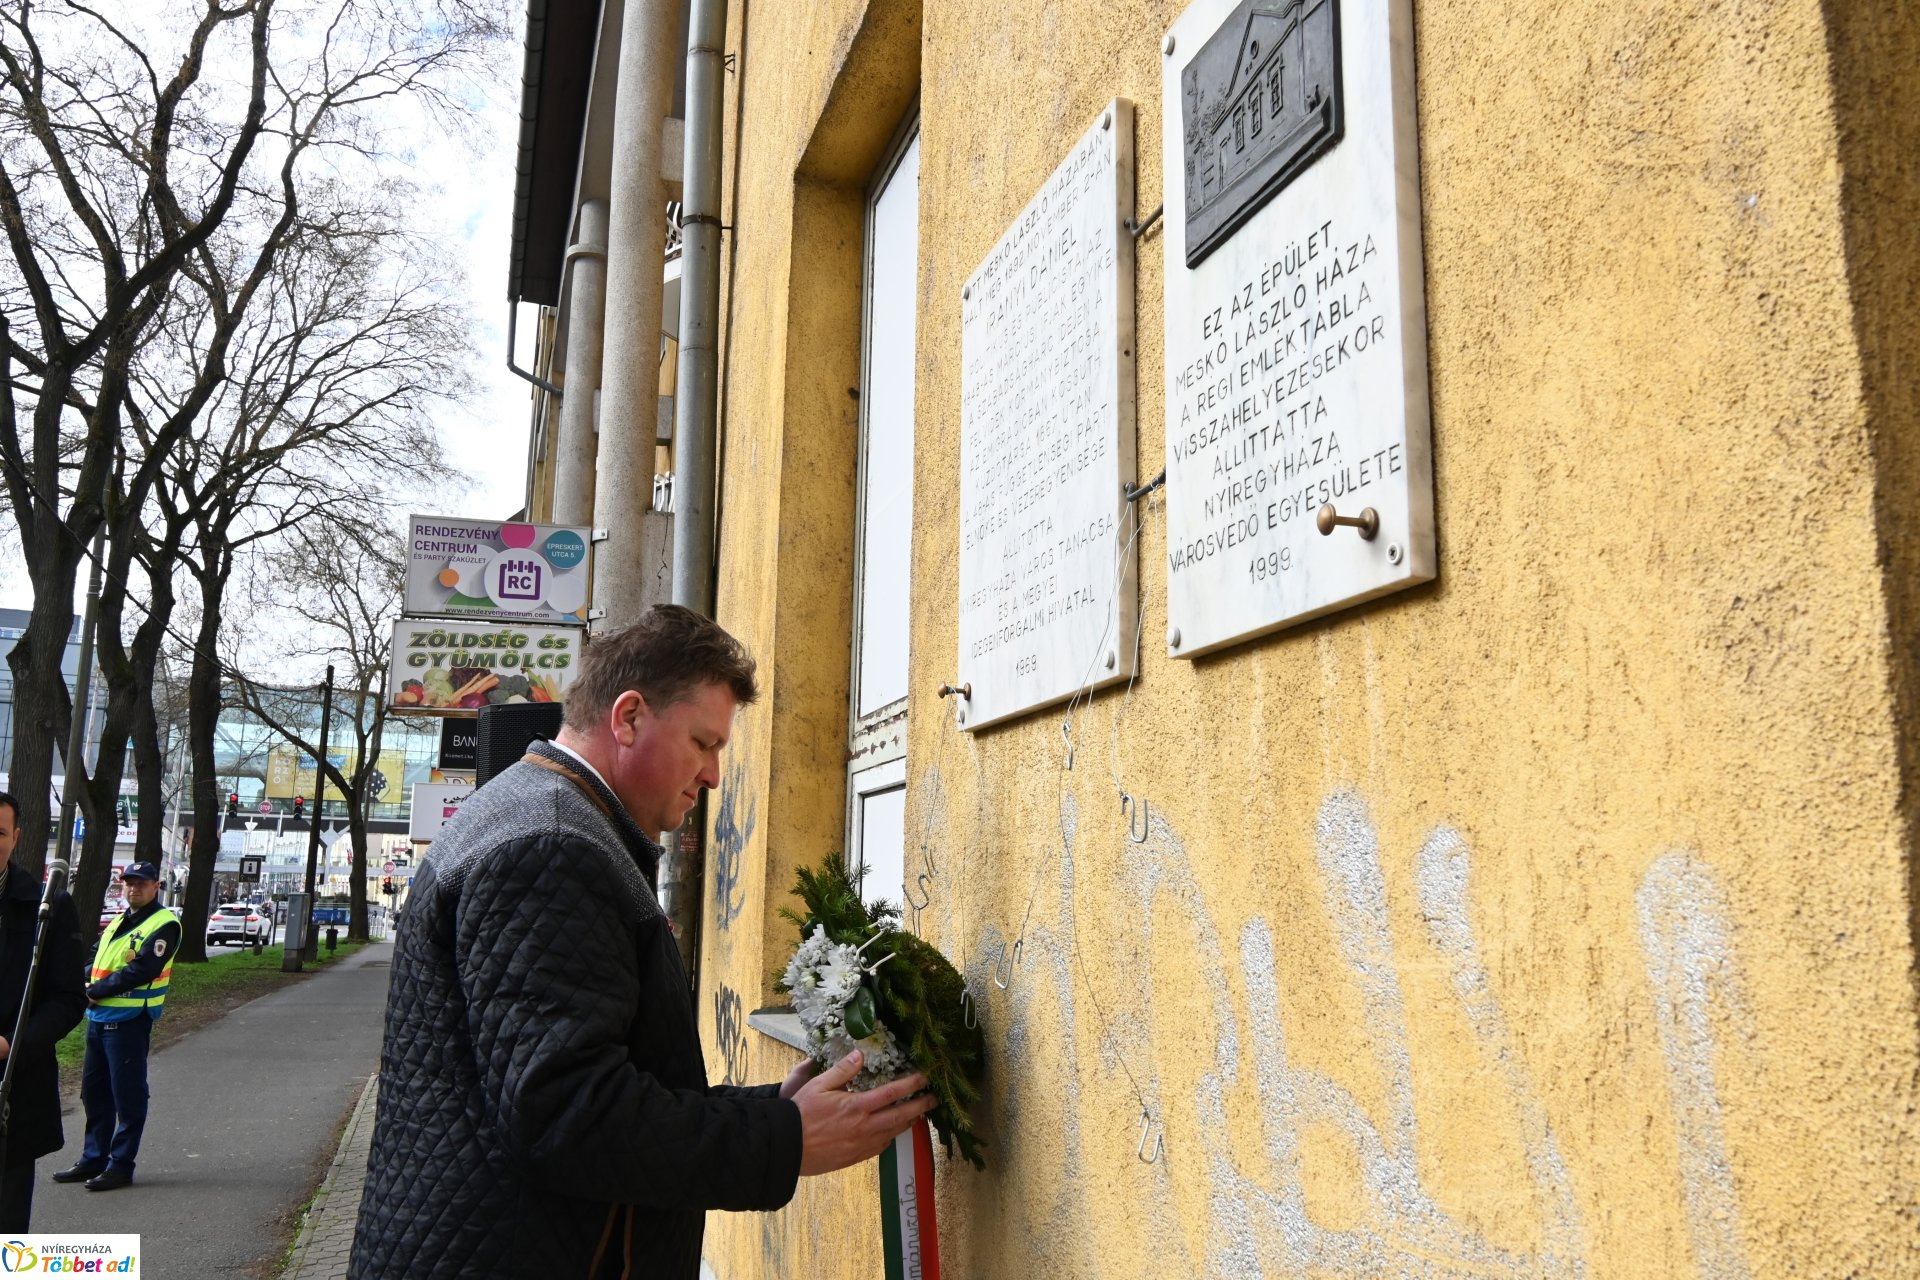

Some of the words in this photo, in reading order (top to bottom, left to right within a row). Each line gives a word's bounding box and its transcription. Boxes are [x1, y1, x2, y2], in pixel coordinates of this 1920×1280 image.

[1088, 228, 1102, 257] AZ
[1204, 307, 1222, 340] EZ
[1231, 282, 1253, 320] AZ
[1262, 220, 1332, 296] ÉPÜLET
[1176, 333, 1227, 396] MESKÓ
[1236, 274, 1306, 354] LÁSZLÓ
[1317, 234, 1377, 296] HÁZA
[1174, 316, 1384, 464] VISSZAHELYEZÉSEKOR
[1181, 404, 1190, 428] A
[1198, 373, 1233, 416] RÉGI
[1213, 396, 1328, 480] ÁLLÍTTATTA
[1205, 431, 1340, 521] NYÍREGYHÁZA
[1268, 443, 1401, 530] EGYESÜLETE
[416, 525, 499, 540] RENDEZVÉNY
[414, 540, 478, 554] CENTRUM
[414, 552, 422, 560] ÉS
[424, 554, 446, 562] PARTY
[547, 543, 583, 551] EPRESKERT
[508, 576, 532, 590] RC
[445, 607, 550, 619] www.rendezvenycentrum.com
[1012, 596, 1019, 613] A
[1048, 583, 1095, 623] HIVATAL
[408, 629, 529, 650] ZÖLDSÉG
[537, 634, 570, 650] és
[407, 649, 571, 670] GYÜMÖLCS
[453, 735, 478, 747] BAN
